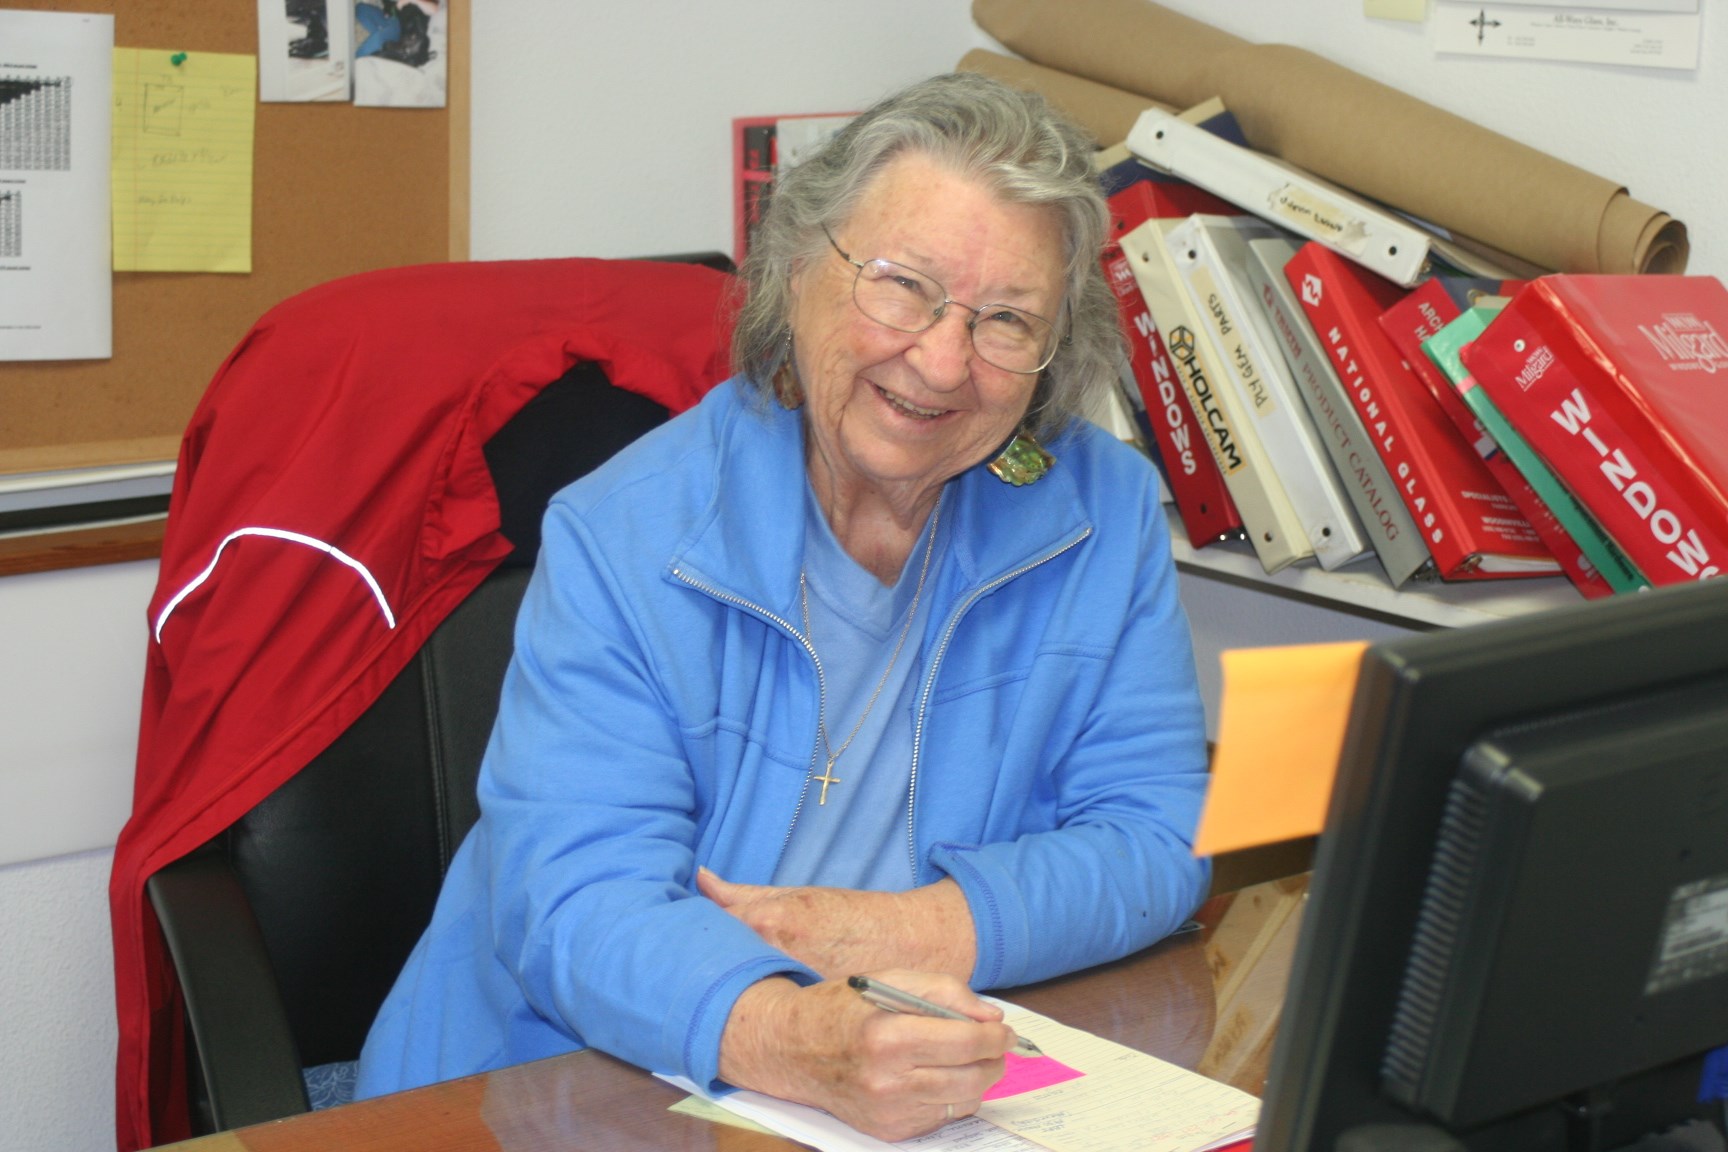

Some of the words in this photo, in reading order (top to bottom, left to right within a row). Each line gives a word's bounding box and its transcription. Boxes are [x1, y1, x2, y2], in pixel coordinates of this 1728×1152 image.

[1208, 293, 1232, 335] PARTS
[1134, 312, 1196, 475] WINDOWS
[1235, 344, 1254, 378] GEM
[1248, 379, 1268, 408] PLY
[1514, 347, 1555, 390] Milgard
[1184, 356, 1242, 470] HOLCAM
[1302, 363, 1351, 448] PRODUCT
[1349, 452, 1399, 541] CATALOG
[1328, 326, 1394, 452] NATIONAL
[1398, 462, 1443, 544] GLASS
